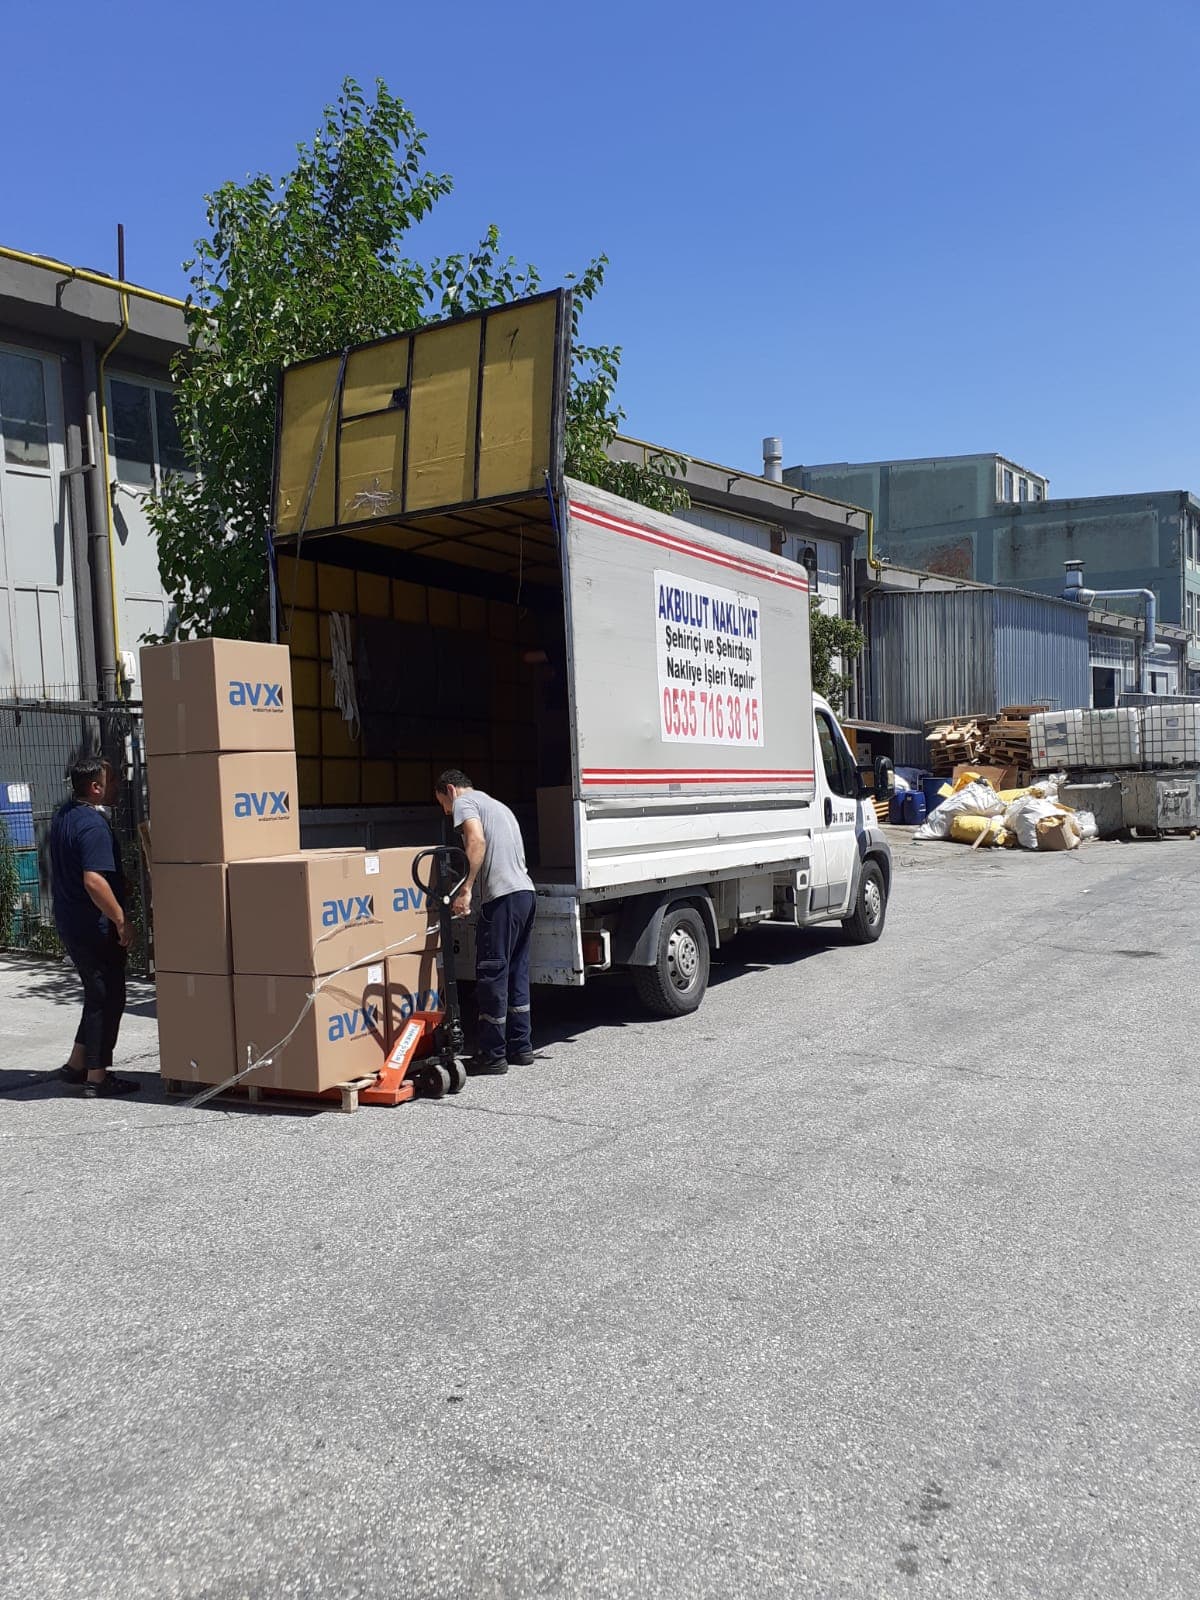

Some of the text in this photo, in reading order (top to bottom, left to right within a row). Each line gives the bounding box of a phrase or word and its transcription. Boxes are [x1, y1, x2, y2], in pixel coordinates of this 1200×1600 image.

[659, 584, 758, 640] AKBULUT NAKLİYAT
[666, 625, 752, 666] Şehiriçi ve Şehirdışı
[667, 656, 702, 686] Nakliye
[704, 658, 727, 688] İşleri
[229, 681, 281, 706] avx
[663, 687, 759, 741] 0535 716 38 15
[234, 791, 287, 818] avx
[322, 895, 372, 927] avx
[328, 1003, 376, 1042] avx
